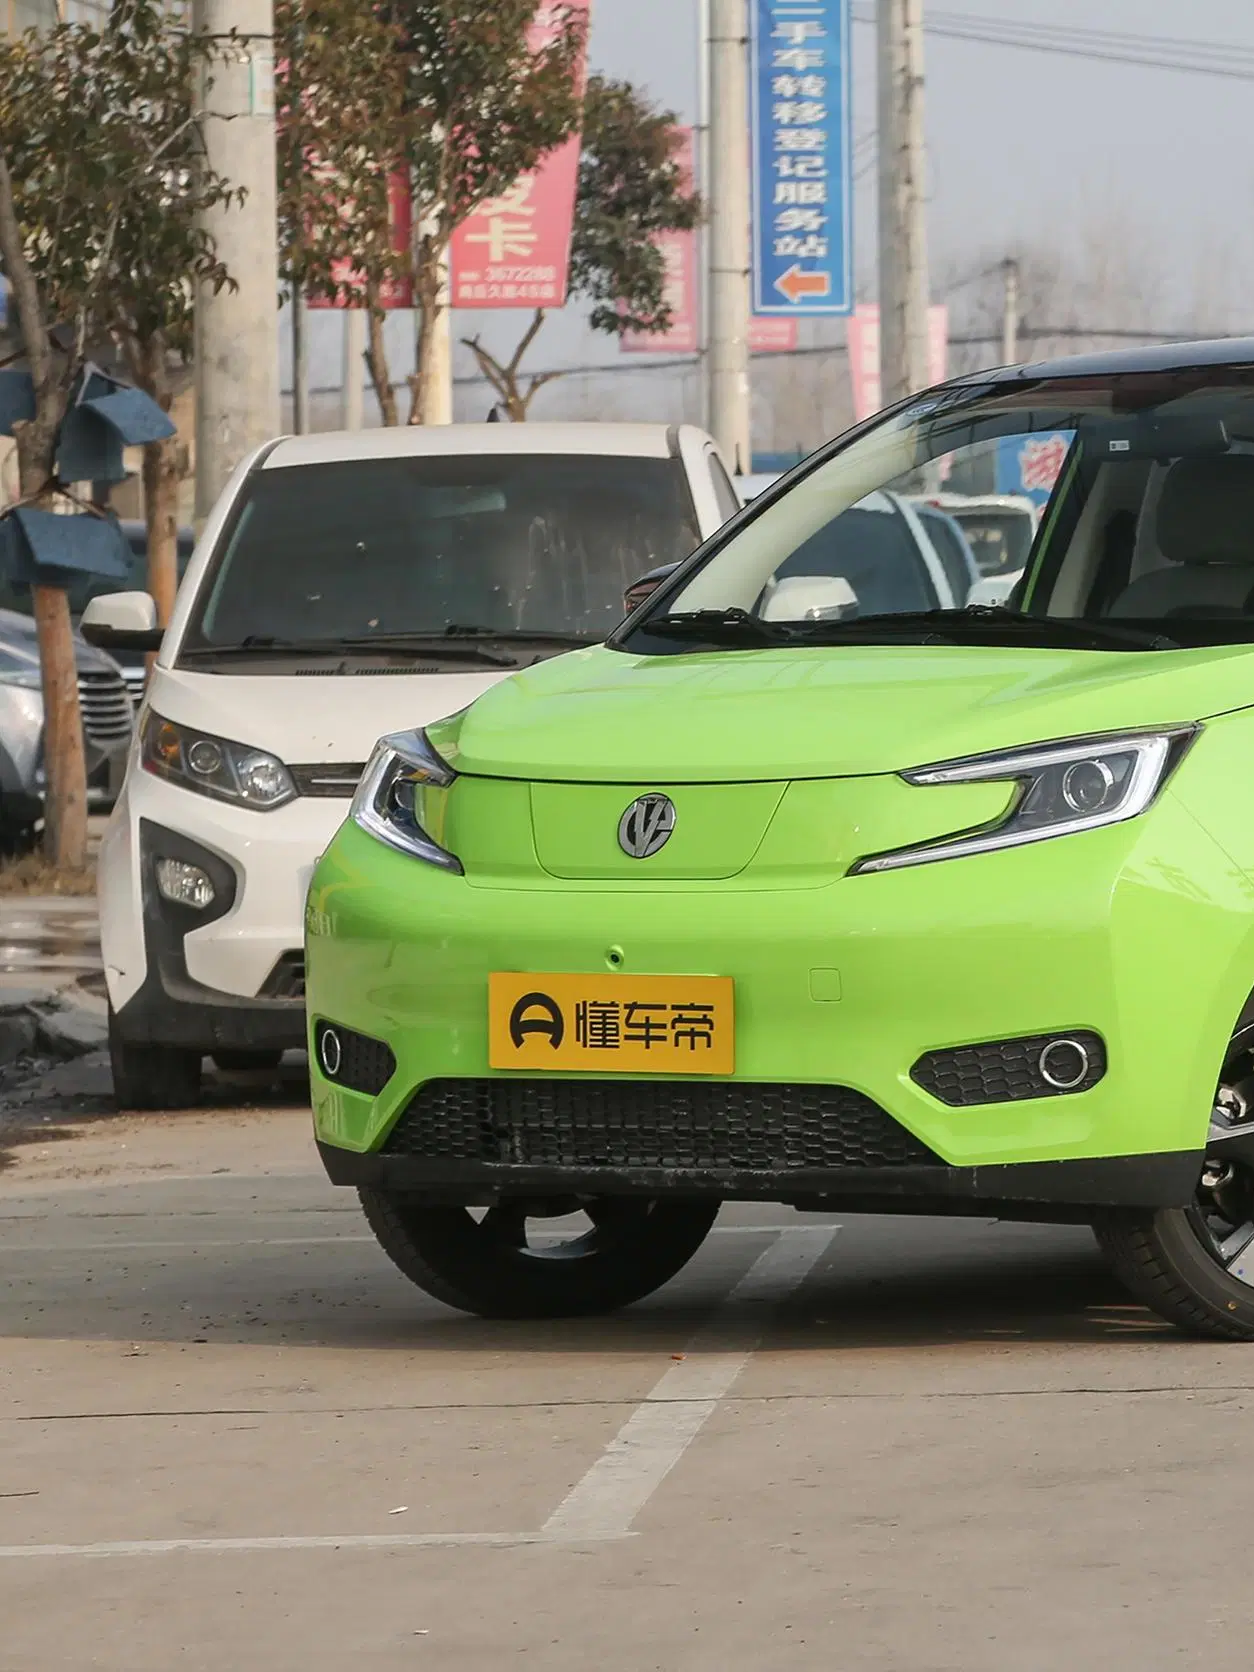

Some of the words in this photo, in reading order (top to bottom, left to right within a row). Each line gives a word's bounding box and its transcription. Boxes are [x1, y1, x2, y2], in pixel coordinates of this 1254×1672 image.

[769, 0, 829, 257] 二手车转移登记服务站
[575, 1000, 714, 1051] 懂车帝
